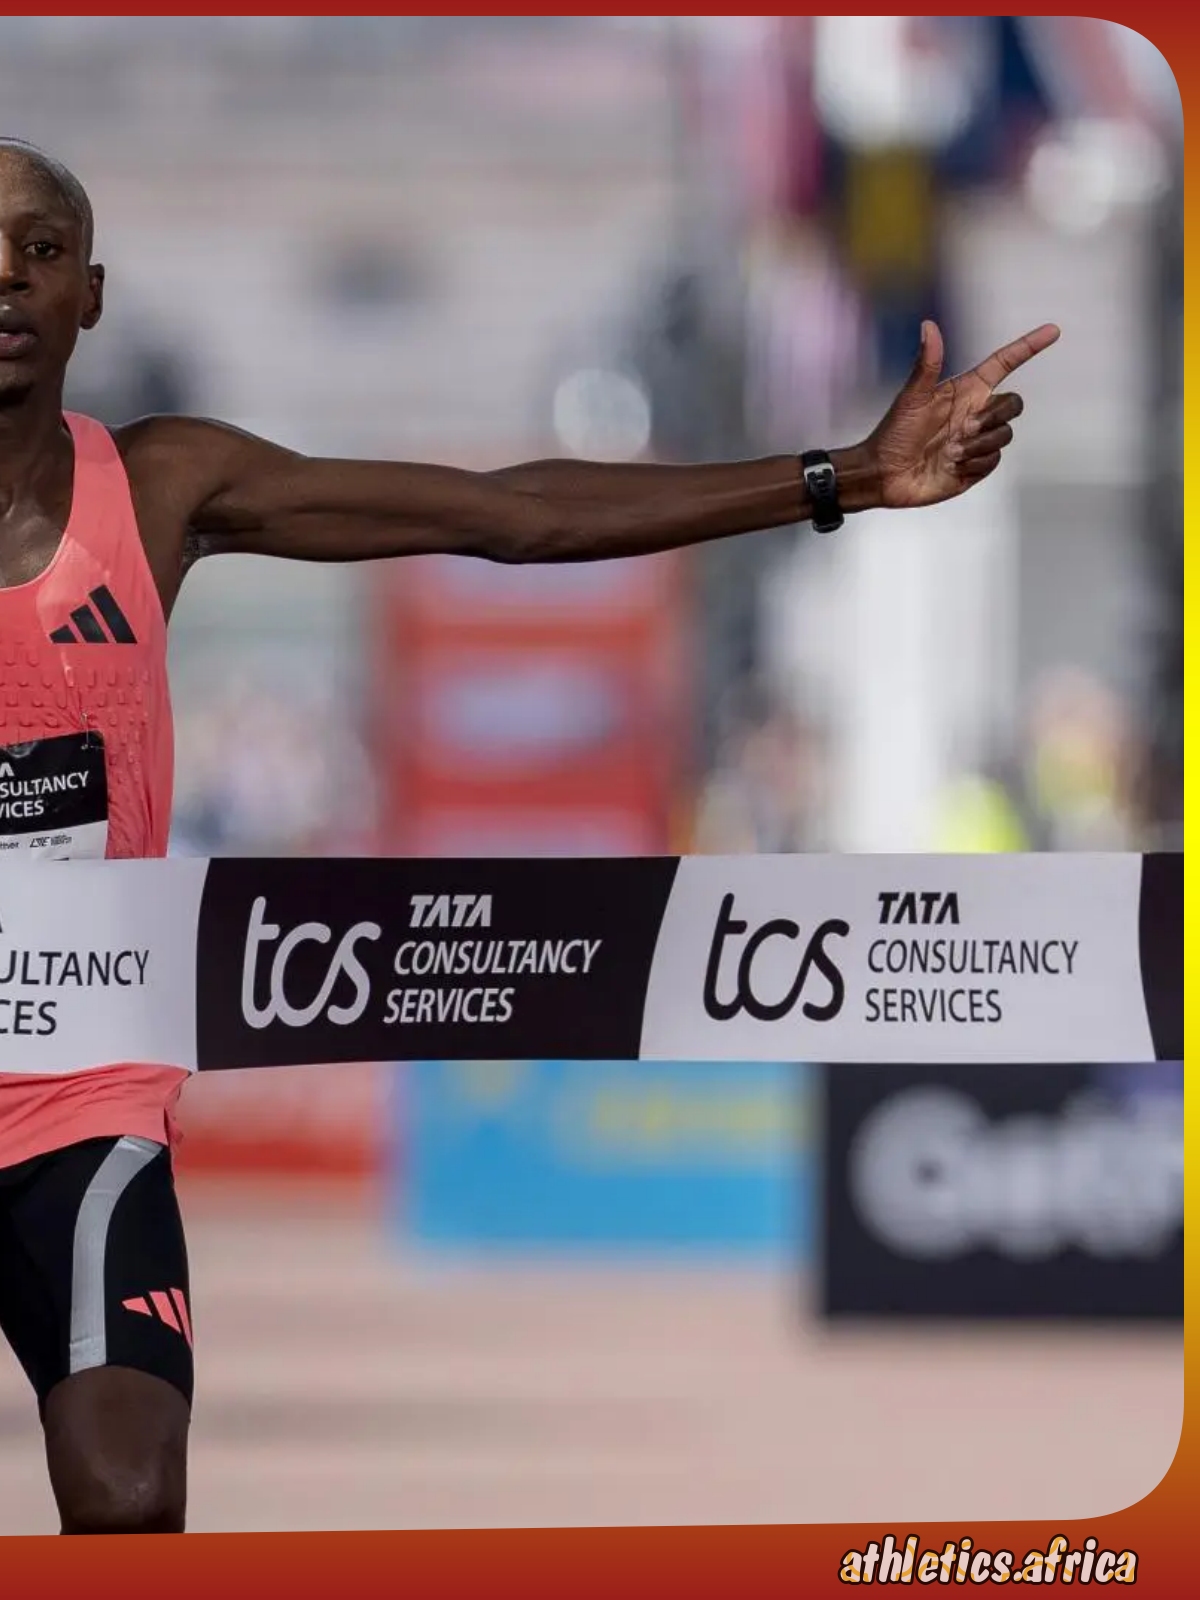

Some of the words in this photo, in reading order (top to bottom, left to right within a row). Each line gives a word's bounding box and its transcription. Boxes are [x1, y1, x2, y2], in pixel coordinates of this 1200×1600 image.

[409, 895, 492, 927] TATA
[877, 892, 960, 925] TATA
[241, 896, 382, 1029] tcs
[393, 939, 602, 975] CONSULTANCY
[703, 893, 850, 1022] tcs
[867, 939, 1079, 975] CONSULTANCY
[383, 987, 515, 1024] SERVICES
[865, 988, 1003, 1023] SERVICES
